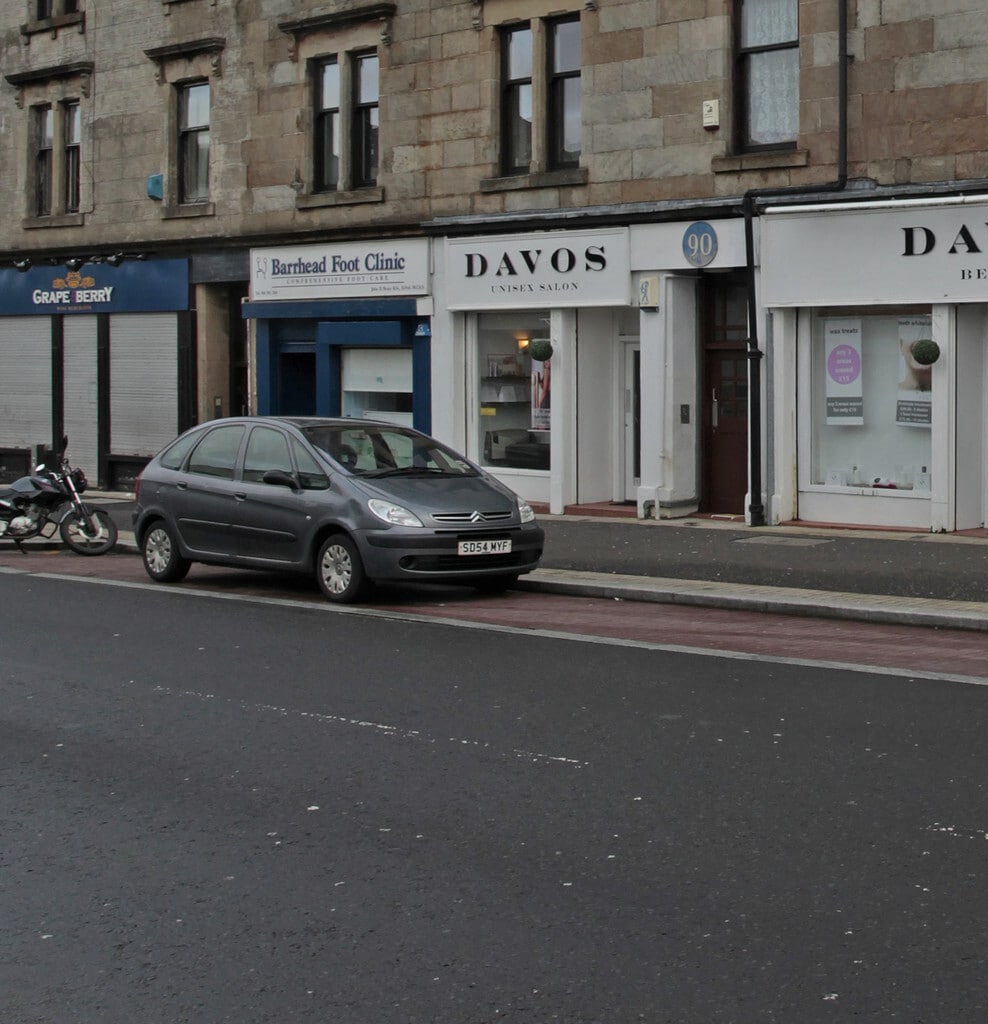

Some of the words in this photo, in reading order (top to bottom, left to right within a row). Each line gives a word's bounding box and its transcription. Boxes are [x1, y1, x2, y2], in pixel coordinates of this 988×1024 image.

[687, 232, 713, 257] 90
[271, 257, 327, 276] Barrhead
[331, 255, 360, 273] Foot
[364, 251, 406, 272] Clinic
[464, 245, 607, 278] DAVOS
[33, 288, 71, 305] GRAPE
[75, 286, 114, 303] BERRY
[490, 283, 534, 294] UNISEX
[539, 281, 579, 292] SALON
[462, 541, 489, 554] SD54
[490, 540, 508, 552] MYF
